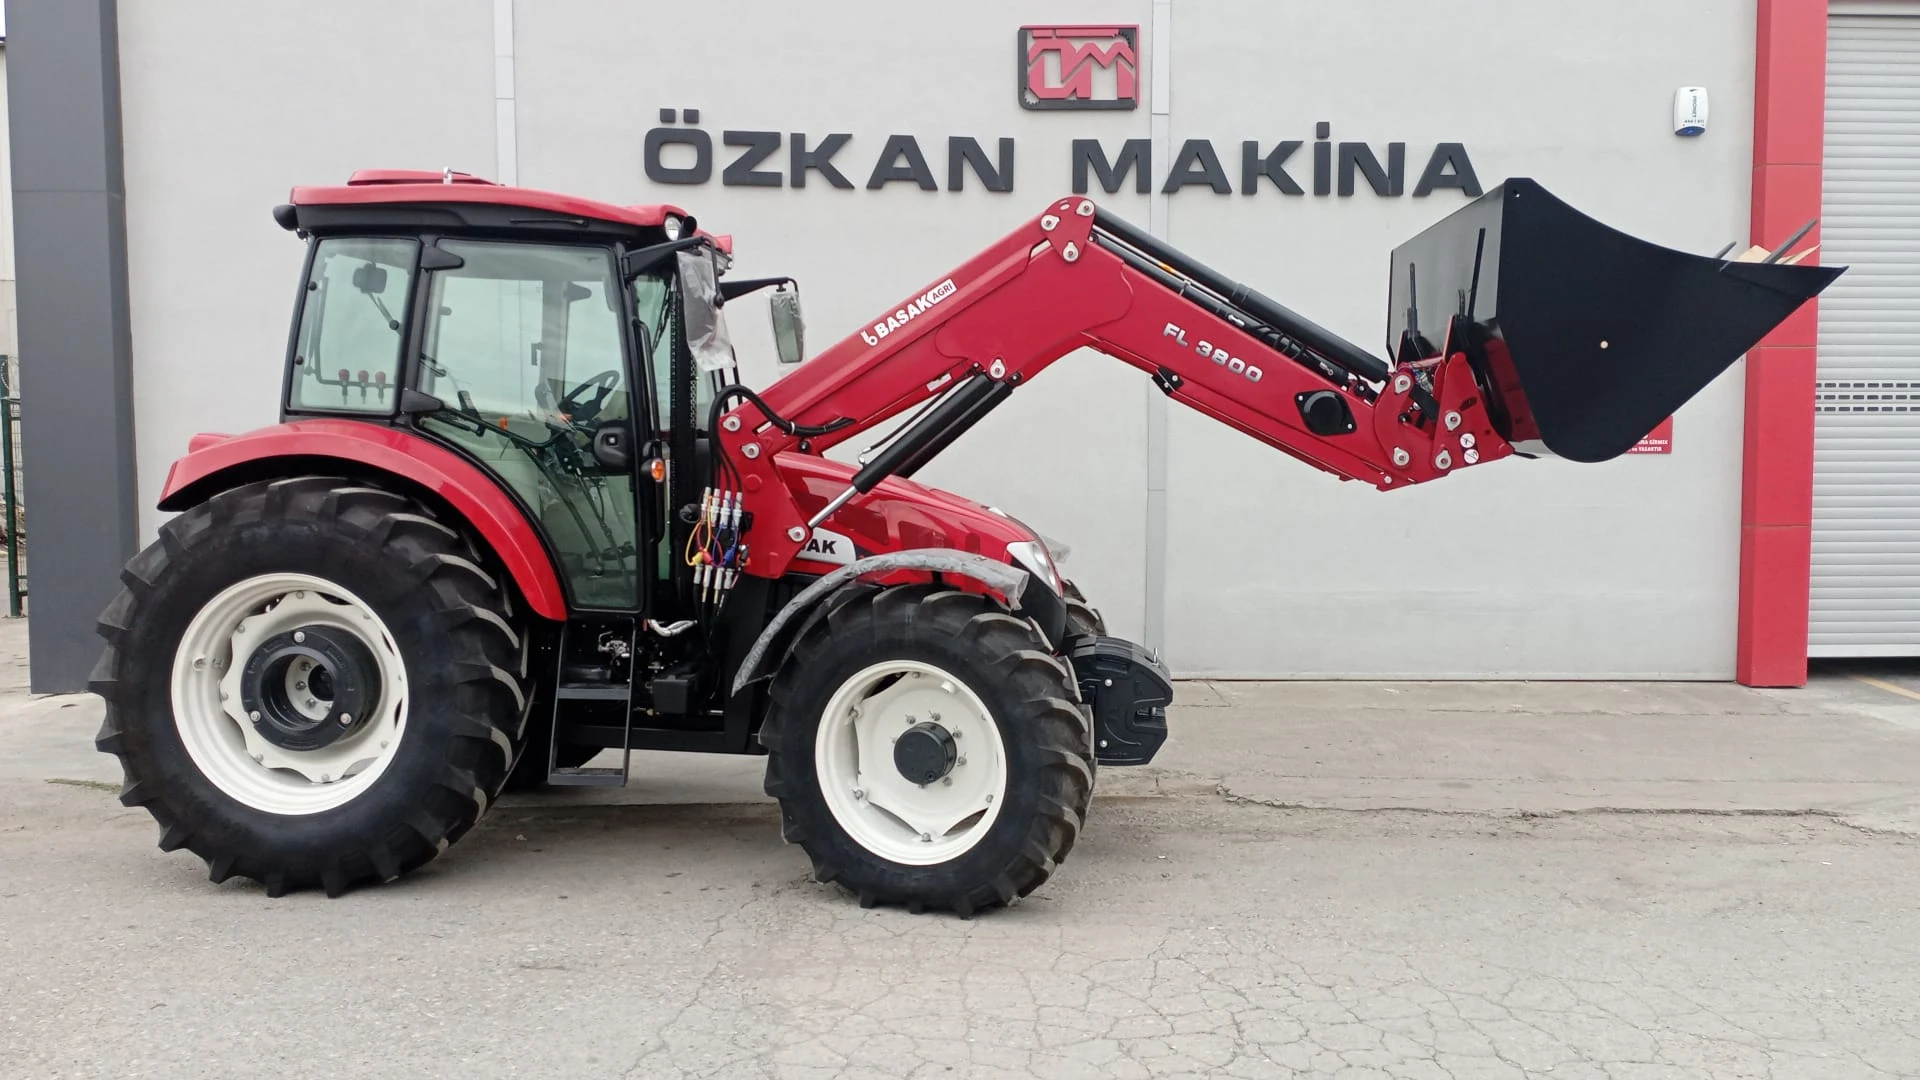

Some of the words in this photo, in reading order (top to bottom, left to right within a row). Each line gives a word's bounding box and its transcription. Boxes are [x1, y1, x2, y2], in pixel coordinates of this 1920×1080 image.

[644, 108, 1015, 192] ÖZKAN
[1071, 121, 1484, 197] MAKİNA
[873, 293, 933, 339] BASAK
[932, 282, 953, 301] AGRI
[1163, 322, 1189, 347] FL
[1195, 340, 1263, 383] 3800
